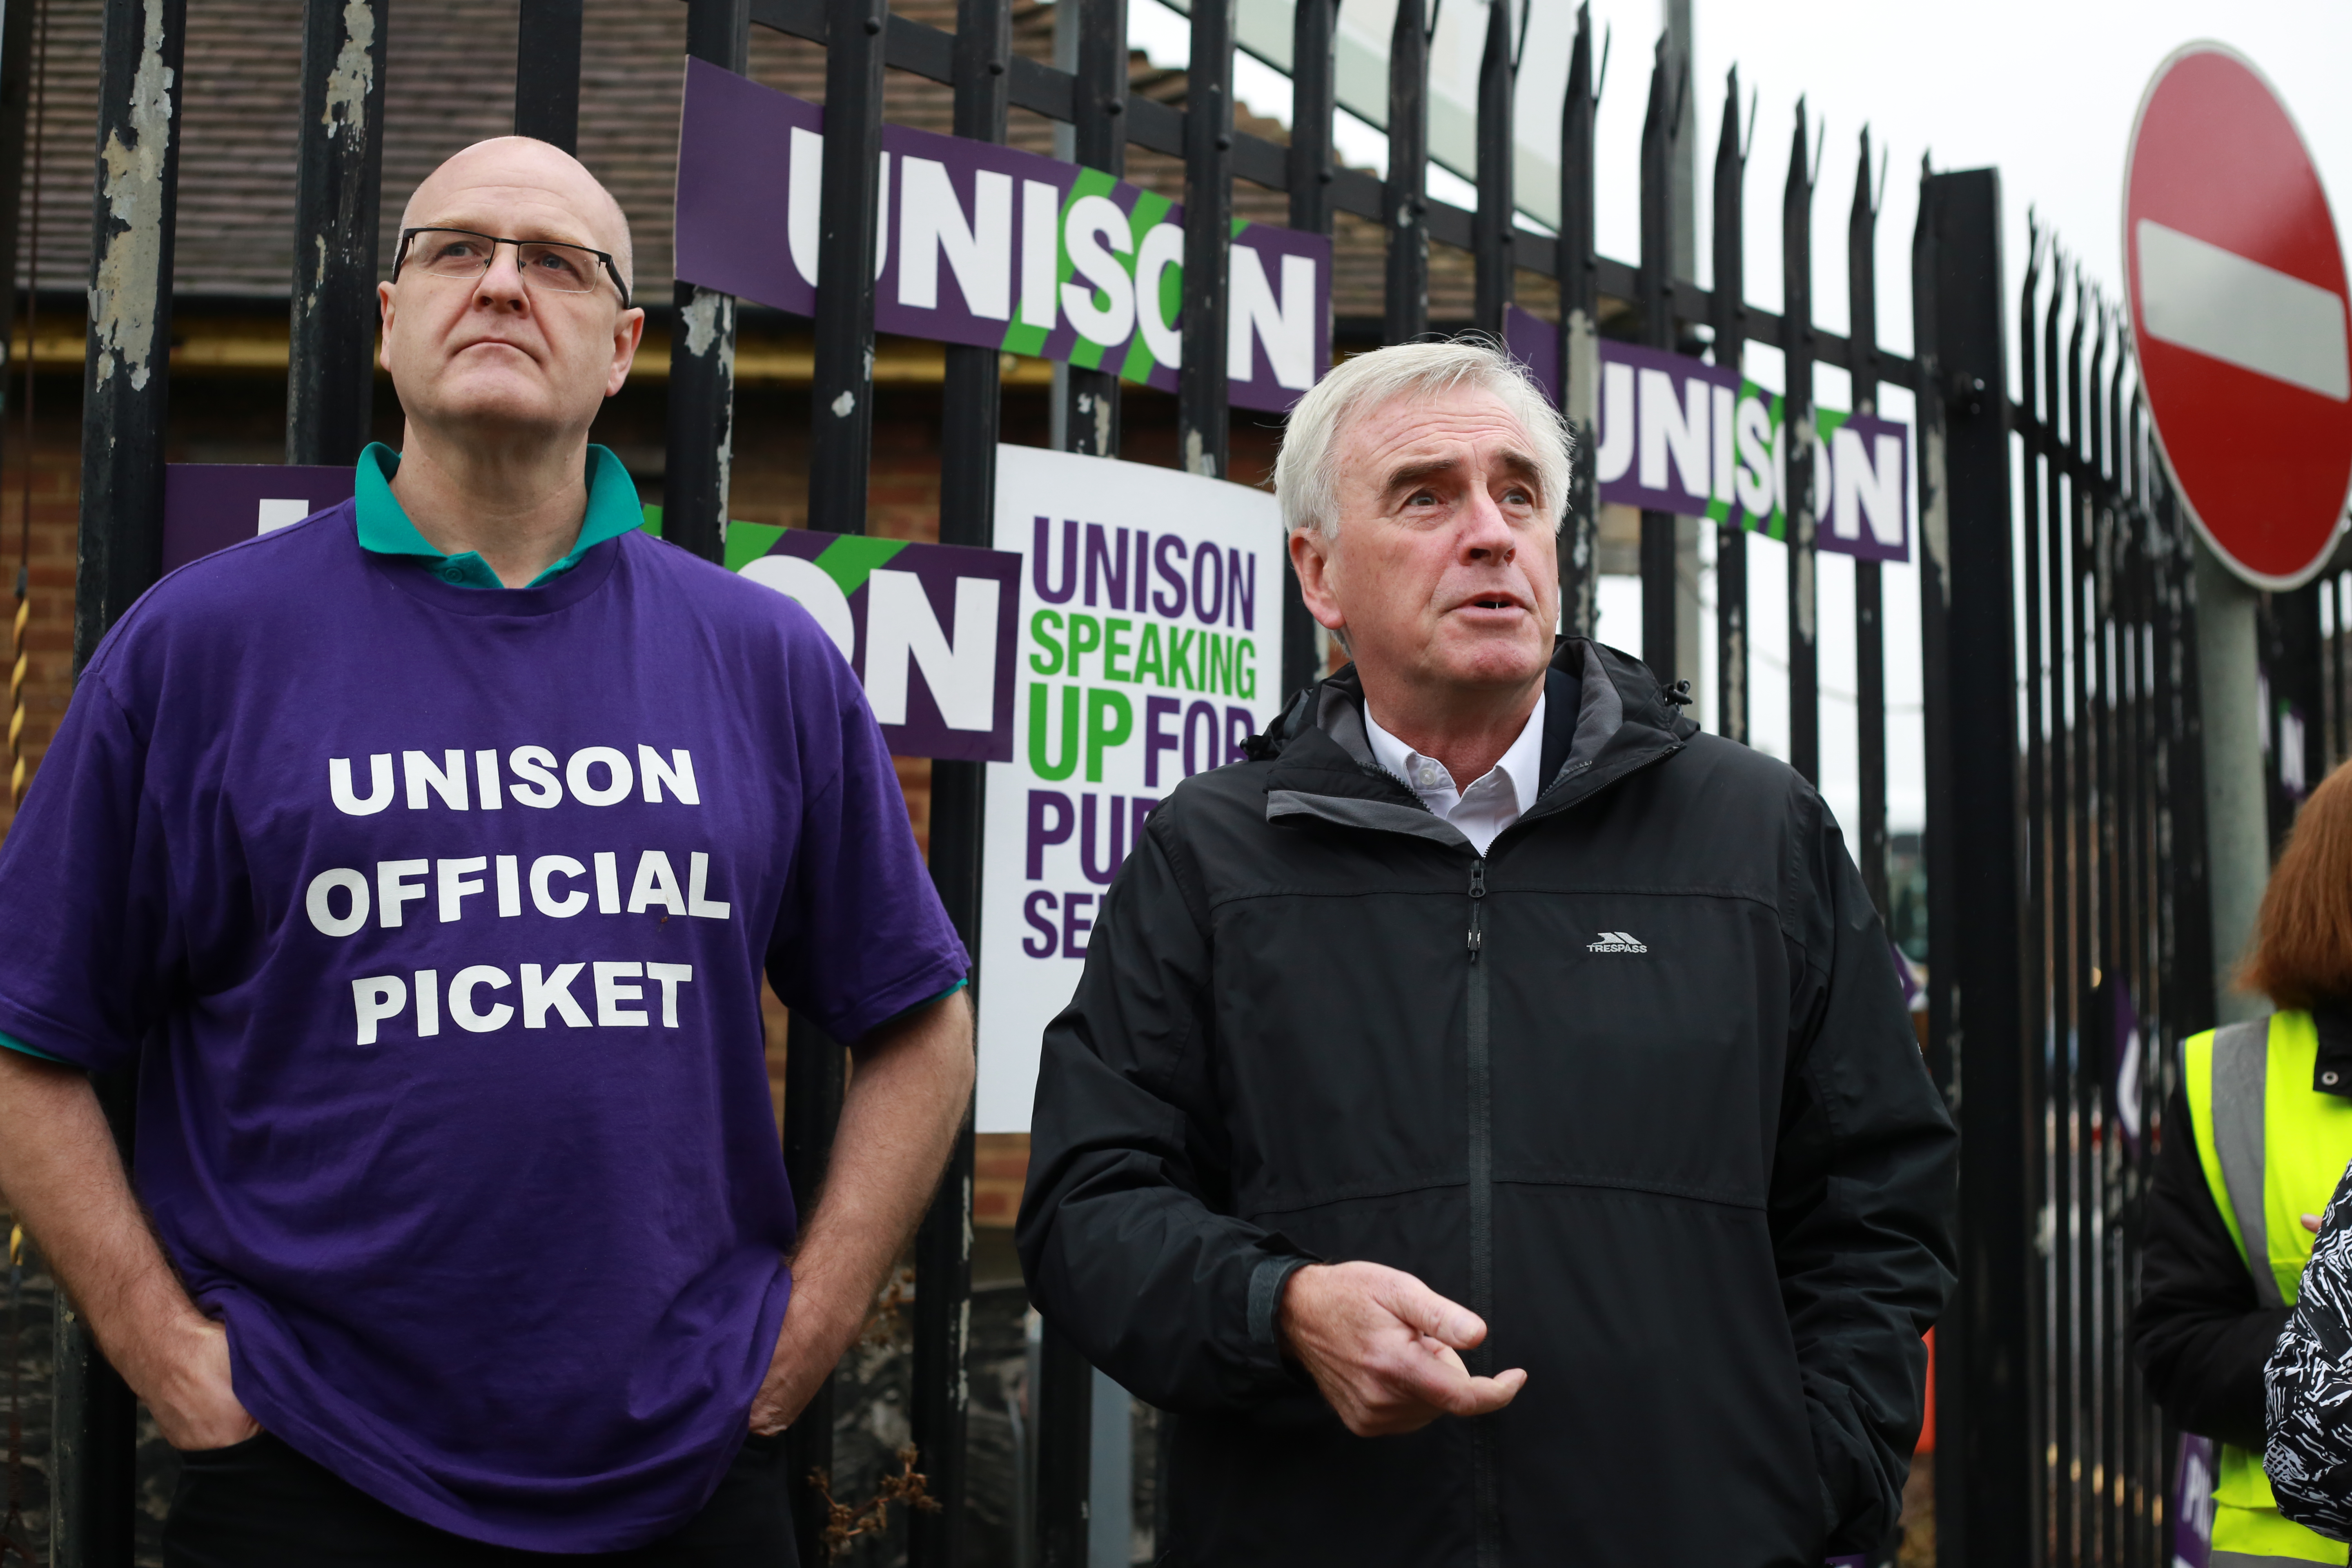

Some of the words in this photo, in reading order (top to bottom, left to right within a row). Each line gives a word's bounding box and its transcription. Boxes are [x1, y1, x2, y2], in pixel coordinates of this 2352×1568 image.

[1033, 516, 1256, 632] UNISON
[1029, 609, 1256, 701] SPEAKING
[1028, 682, 1133, 783] UP
[329, 744, 700, 816] UNISON
[306, 850, 731, 937] OFFICIAL
[1022, 890, 1106, 959] SE
[1586, 944, 1647, 953] TRESPASS
[352, 961, 692, 1045] PICKET
